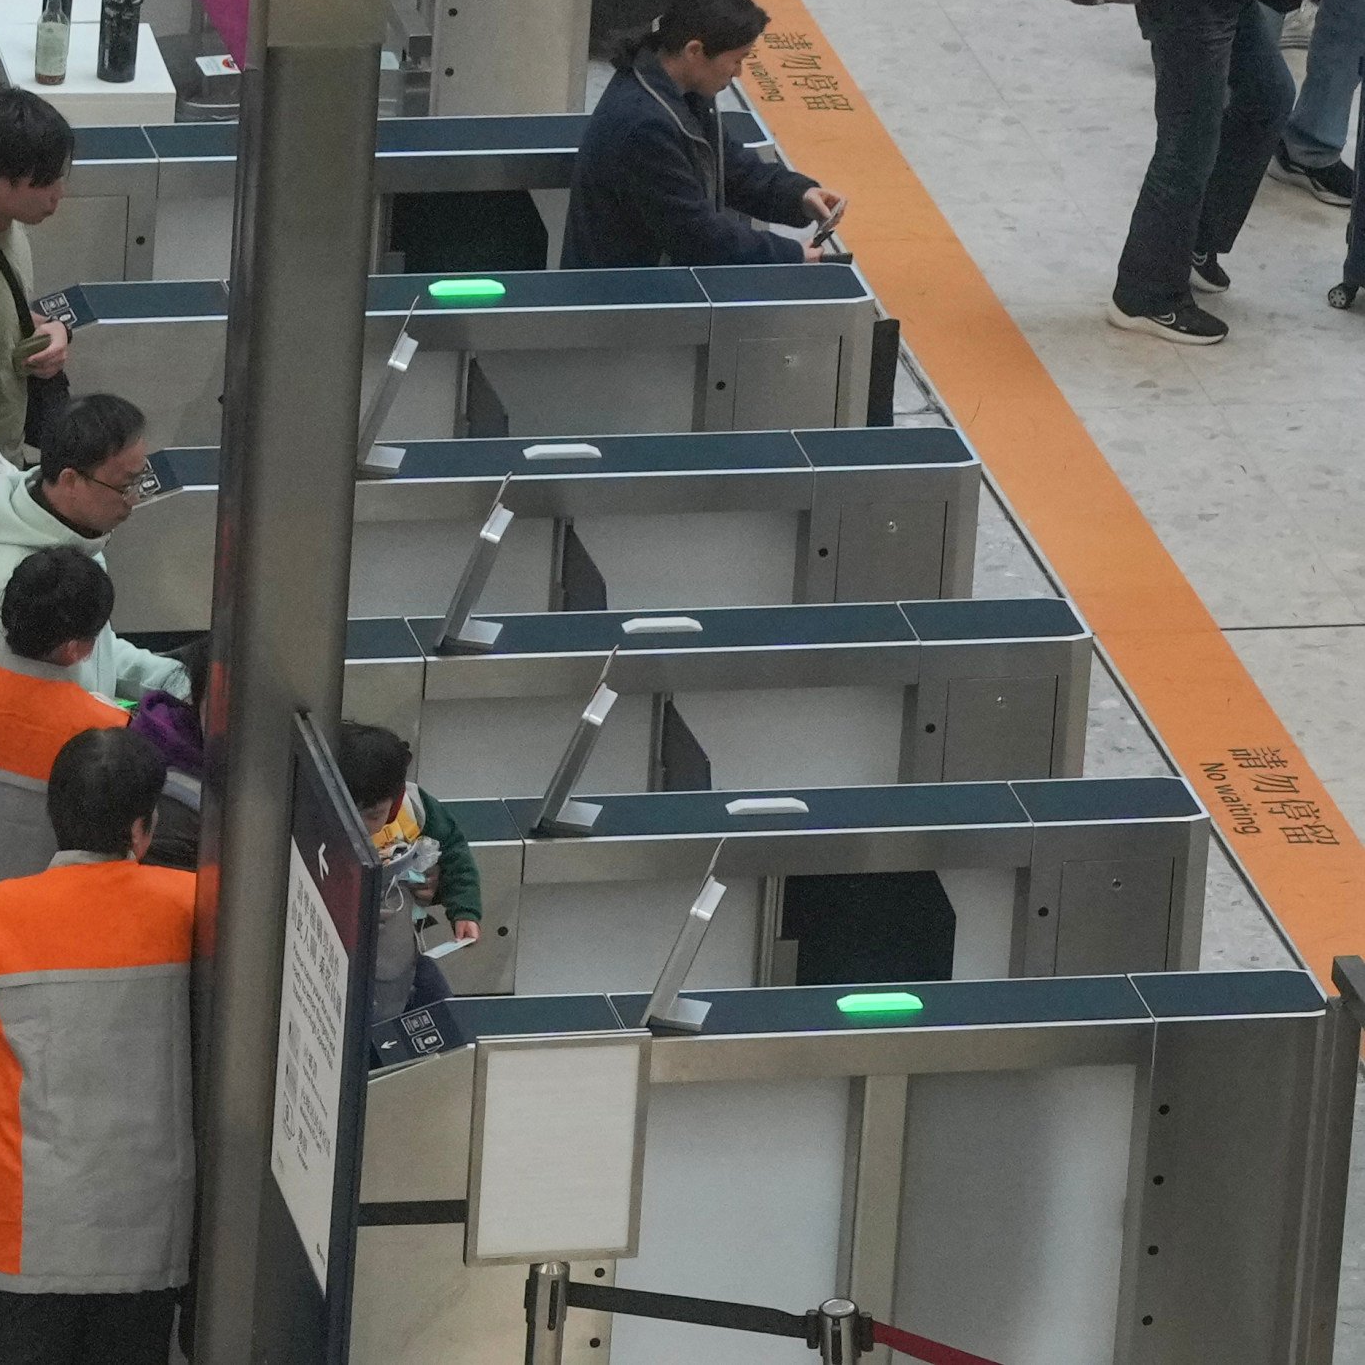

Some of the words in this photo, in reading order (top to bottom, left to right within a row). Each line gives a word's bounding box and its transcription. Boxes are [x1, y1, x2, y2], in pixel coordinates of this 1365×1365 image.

[747, 60, 785, 102] waiting
[1199, 761, 1229, 782] No
[1214, 783, 1263, 835] waiting
[1227, 746, 1341, 846] 請勿停留
